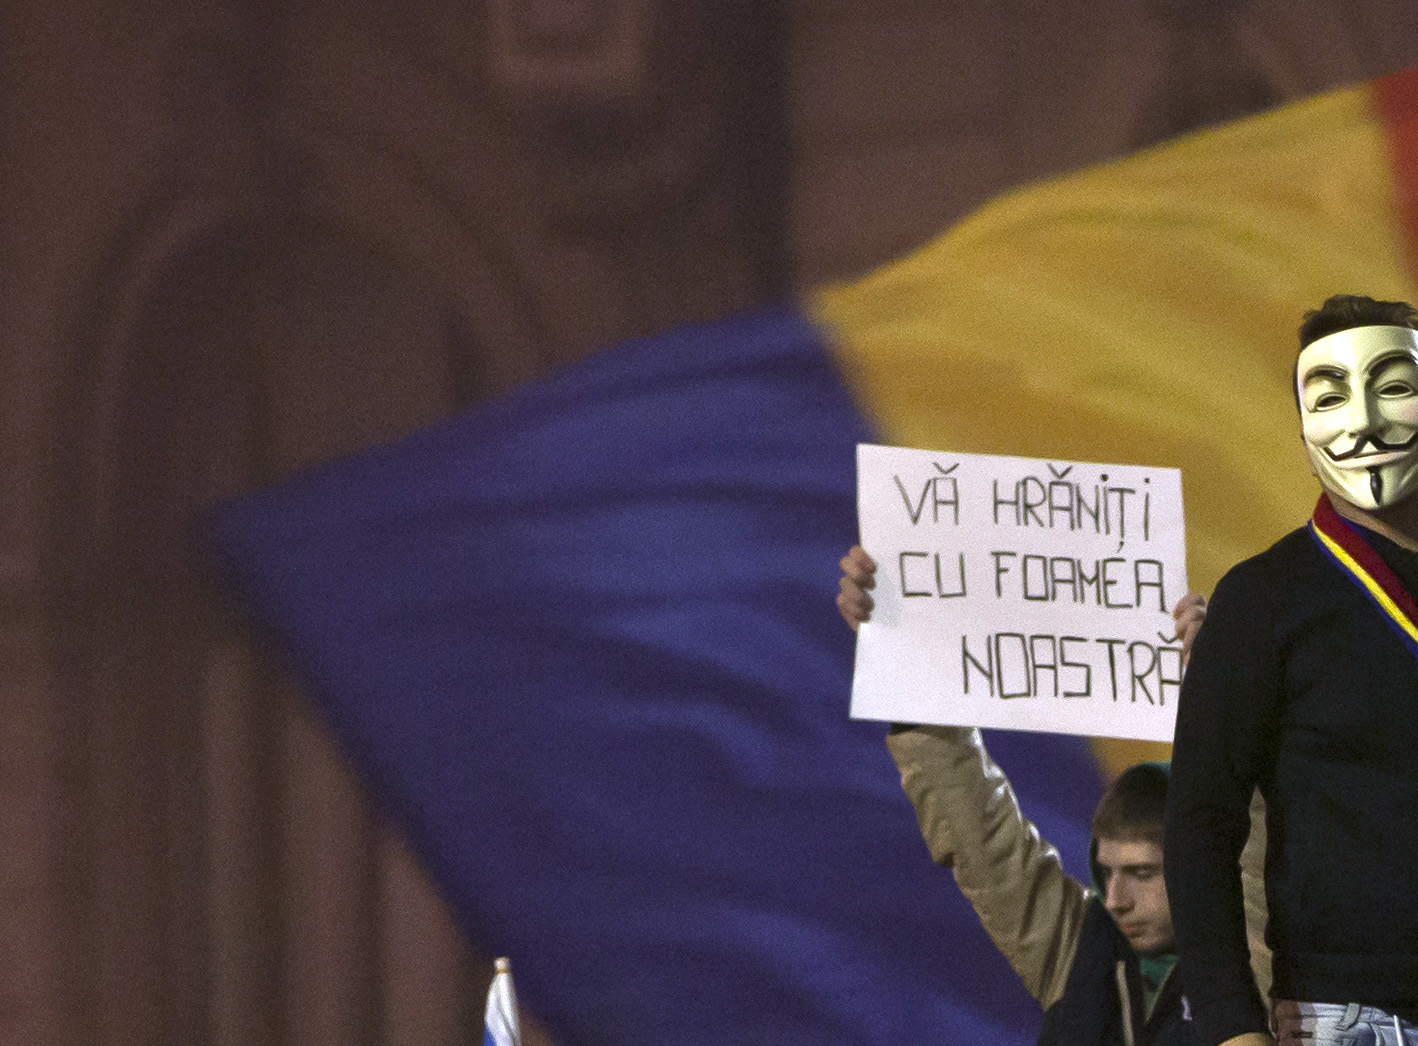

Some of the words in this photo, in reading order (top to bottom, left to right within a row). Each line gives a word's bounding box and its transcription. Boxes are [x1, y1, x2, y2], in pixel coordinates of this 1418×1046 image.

[893, 461, 960, 526] VĂ
[898, 551, 967, 598] CU
[990, 550, 1171, 613] FOAMEA
[961, 631, 1185, 706] NOASTRĂ
